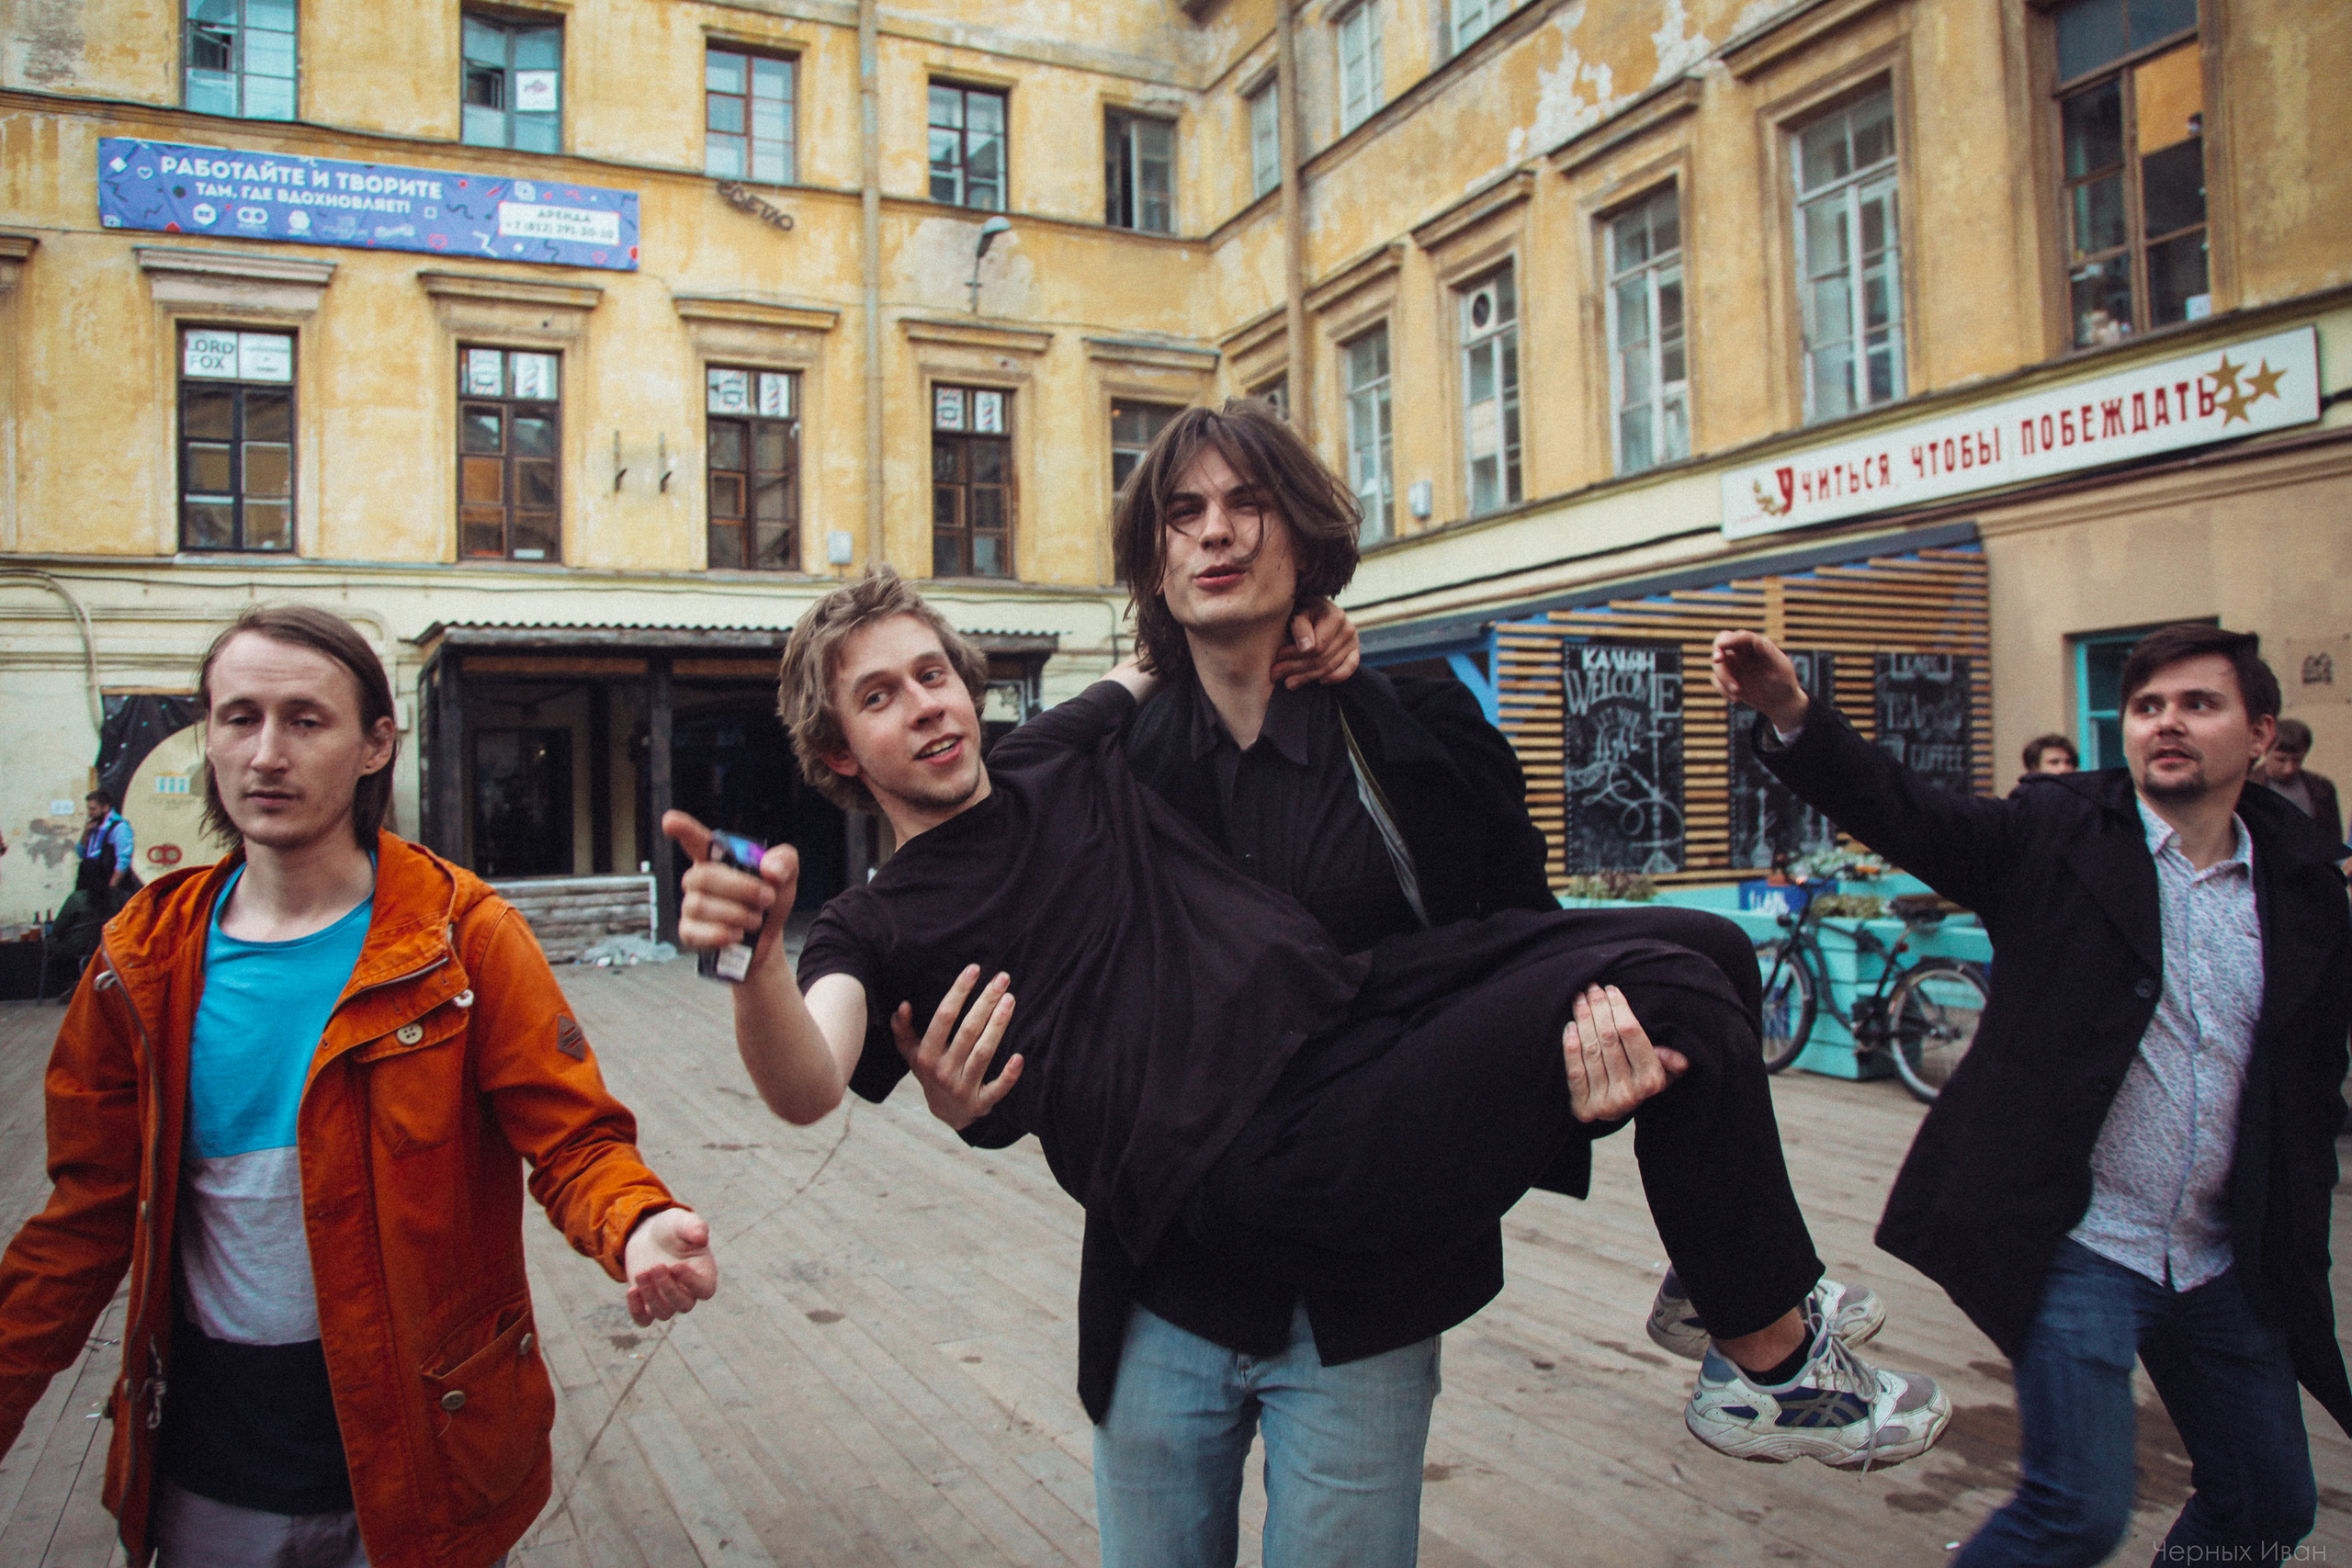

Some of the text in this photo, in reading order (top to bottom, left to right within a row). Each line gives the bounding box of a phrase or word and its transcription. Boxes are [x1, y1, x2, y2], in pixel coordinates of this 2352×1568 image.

[161, 155, 444, 200] РАБОТАЙТЕ И ТВОРИТЕ
[195, 181, 239, 199] ТАМ,
[241, 185, 274, 201] ГДЕ
[538, 209, 591, 222] АРЕНДА
[189, 354, 224, 370] FOX
[1911, 426, 2001, 479] ЧТОБЫ
[2021, 377, 2217, 457] ПОБЕЖДАТЬ
[1563, 669, 1683, 718] WELCOME
